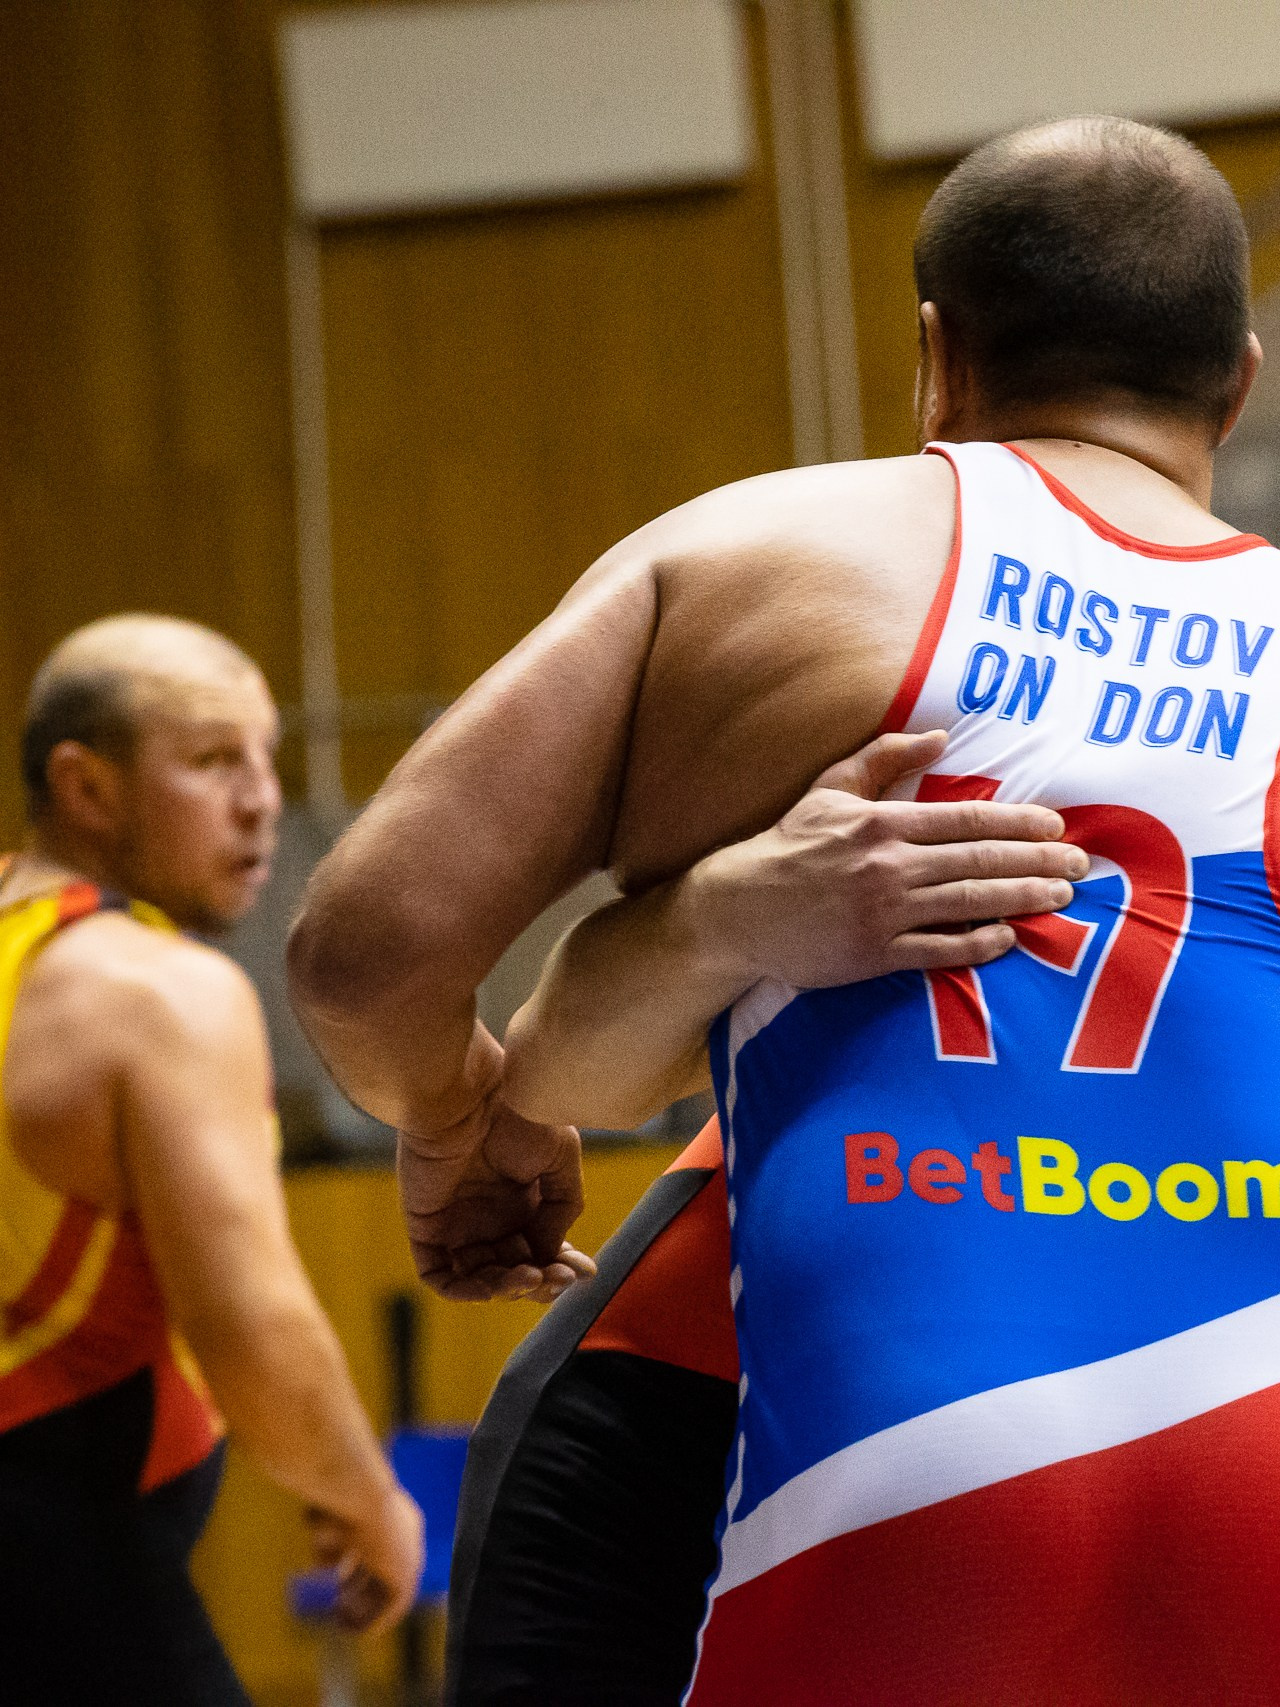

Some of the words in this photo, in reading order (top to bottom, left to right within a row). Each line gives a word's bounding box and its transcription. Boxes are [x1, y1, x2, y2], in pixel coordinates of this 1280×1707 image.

[979, 553, 1274, 677] ROSTOV
[957, 642, 1056, 725] ON
[1085, 680, 1250, 760] DON
